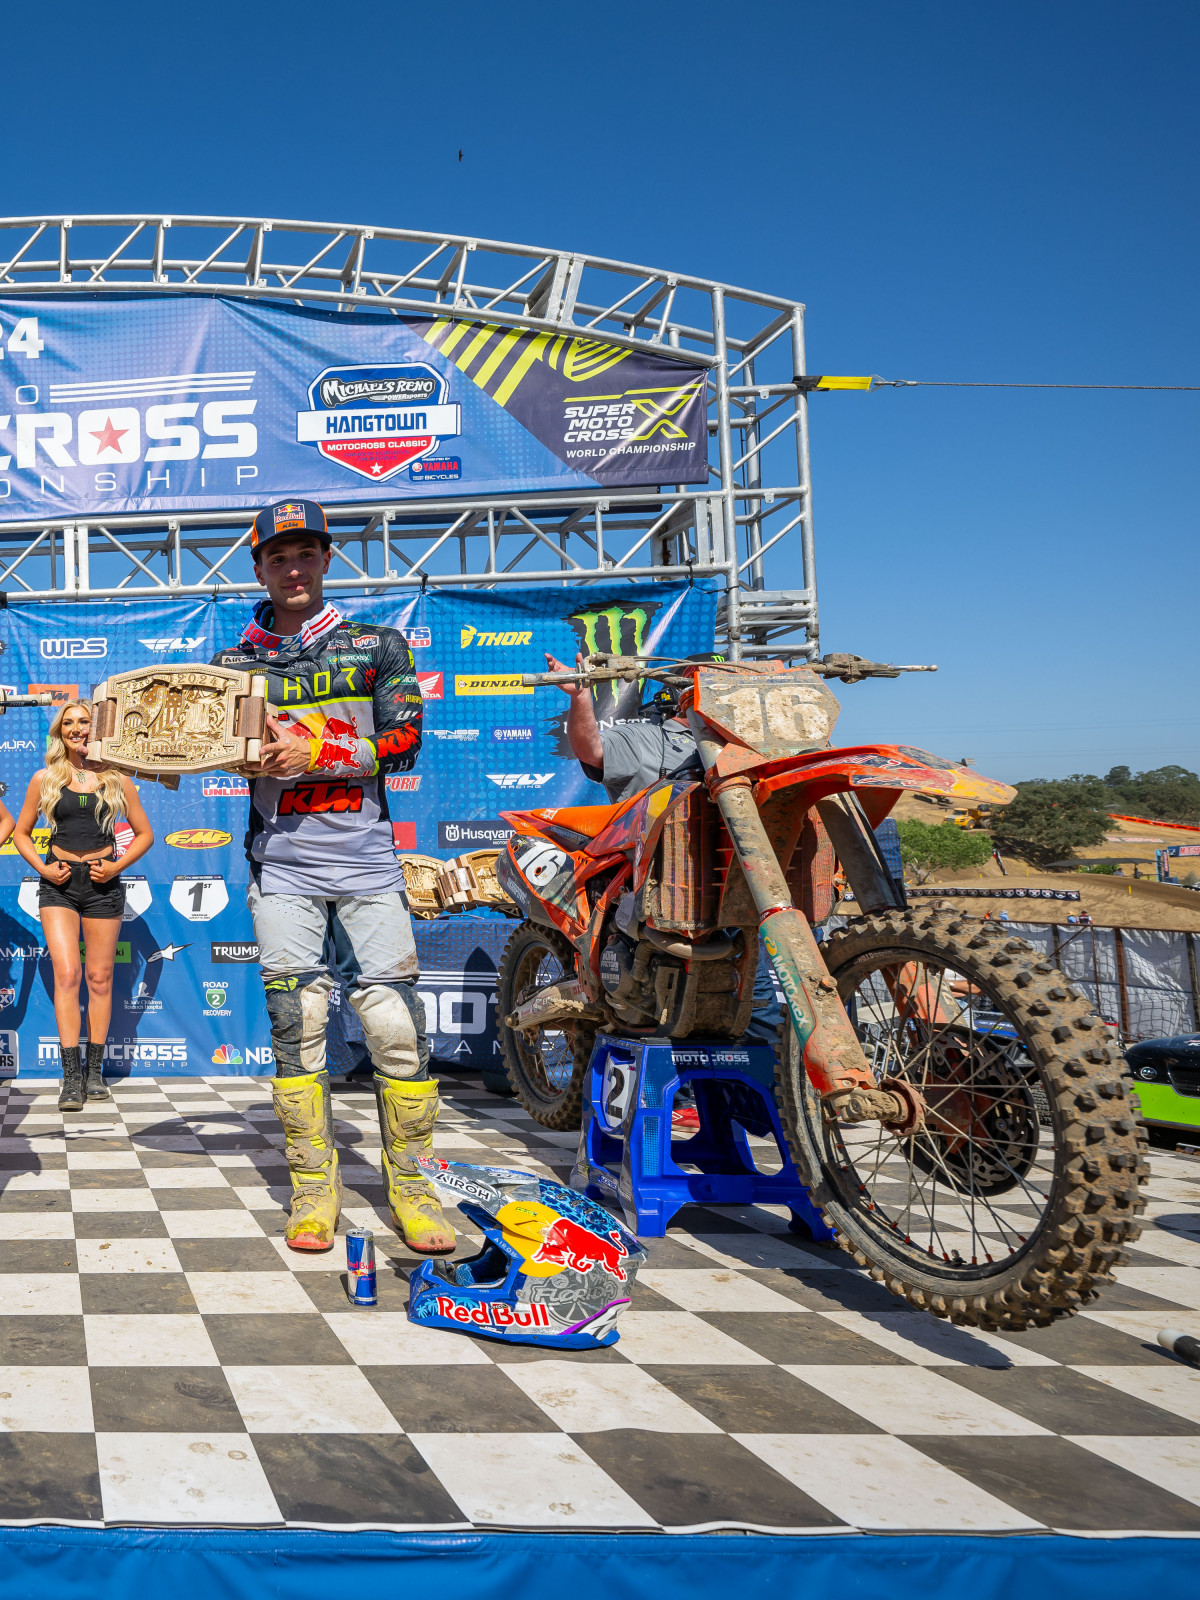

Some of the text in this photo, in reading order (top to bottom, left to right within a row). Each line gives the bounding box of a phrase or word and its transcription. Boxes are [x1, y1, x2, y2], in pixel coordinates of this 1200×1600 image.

[397, 380, 433, 393] RENO
[563, 403, 636, 419] SUPER
[326, 412, 427, 434] HANGTOWN
[568, 416, 633, 430] MOTO
[563, 428, 635, 443] CROSS
[327, 440, 427, 451] MOTOCROSS CLASSIC
[566, 442, 696, 458] WORLD CHAMPIONSHIP
[422, 461, 459, 471] YAMAHA
[138, 636, 207, 649] FLY
[477, 631, 533, 646] THOR
[40, 638, 108, 659] WPS
[177, 674, 219, 685] 2024
[470, 679, 524, 688] DUNLO
[715, 687, 829, 743] 16
[376, 723, 420, 758] KTM
[502, 729, 532, 738] YAMAHA
[204, 777, 249, 788] PAR
[486, 773, 556, 785] FLY
[204, 788, 250, 796] UNLIMI
[278, 781, 363, 814] KTM
[169, 831, 232, 844] FMF
[213, 946, 259, 957] TRIUMP
[772, 954, 810, 1025] MOTOREX
[211, 994, 220, 1005] 2
[245, 1047, 274, 1065] NB
[671, 1054, 750, 1063] MOTOCROSS
[606, 1067, 625, 1119] 2
[437, 1172, 491, 1201] AIROH
[493, 1237, 518, 1258] AIROH
[359, 1260, 374, 1270] Bull
[436, 1296, 550, 1327] Red Bull
